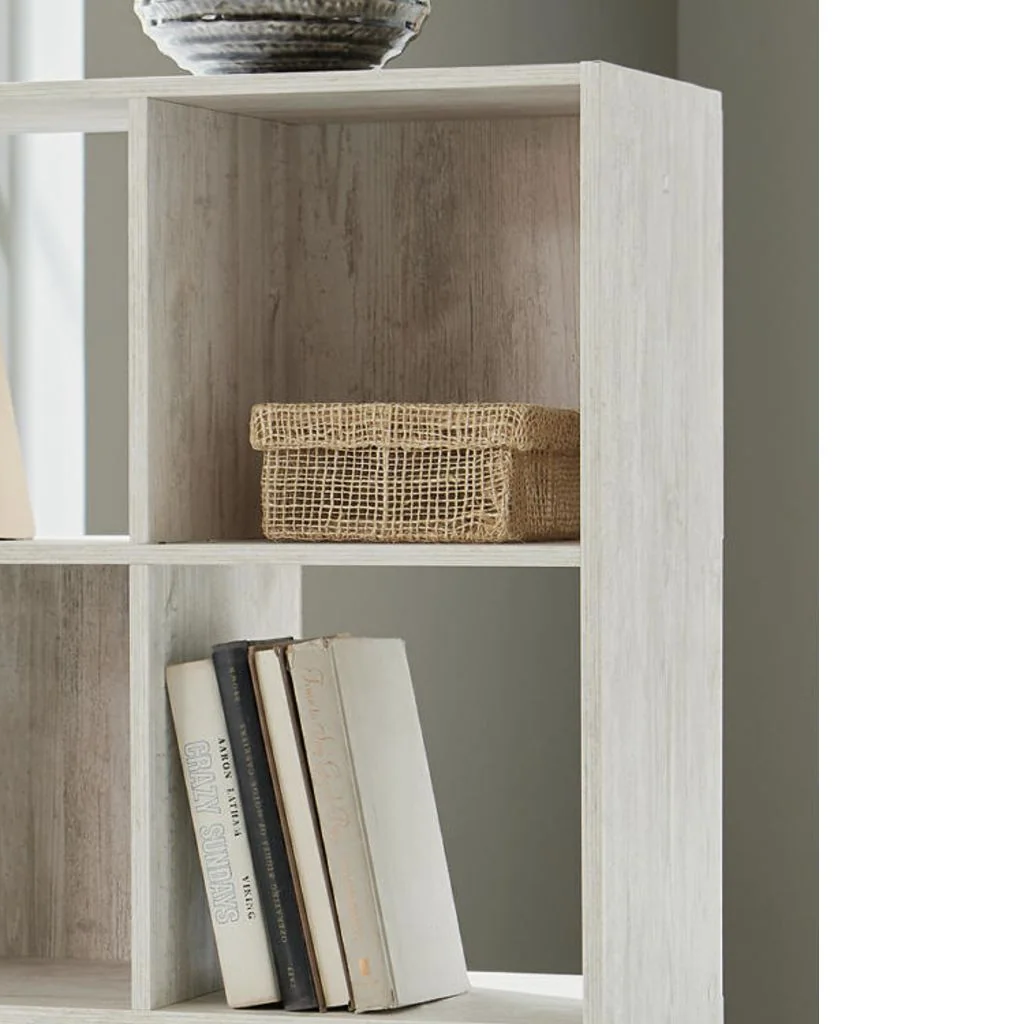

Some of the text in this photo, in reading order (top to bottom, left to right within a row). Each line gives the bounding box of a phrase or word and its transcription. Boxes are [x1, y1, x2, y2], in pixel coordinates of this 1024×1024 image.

[184, 740, 240, 925] CRAZY SUNDAYS
[218, 738, 243, 837] AARON LATHAM
[241, 875, 256, 920] VIKING
